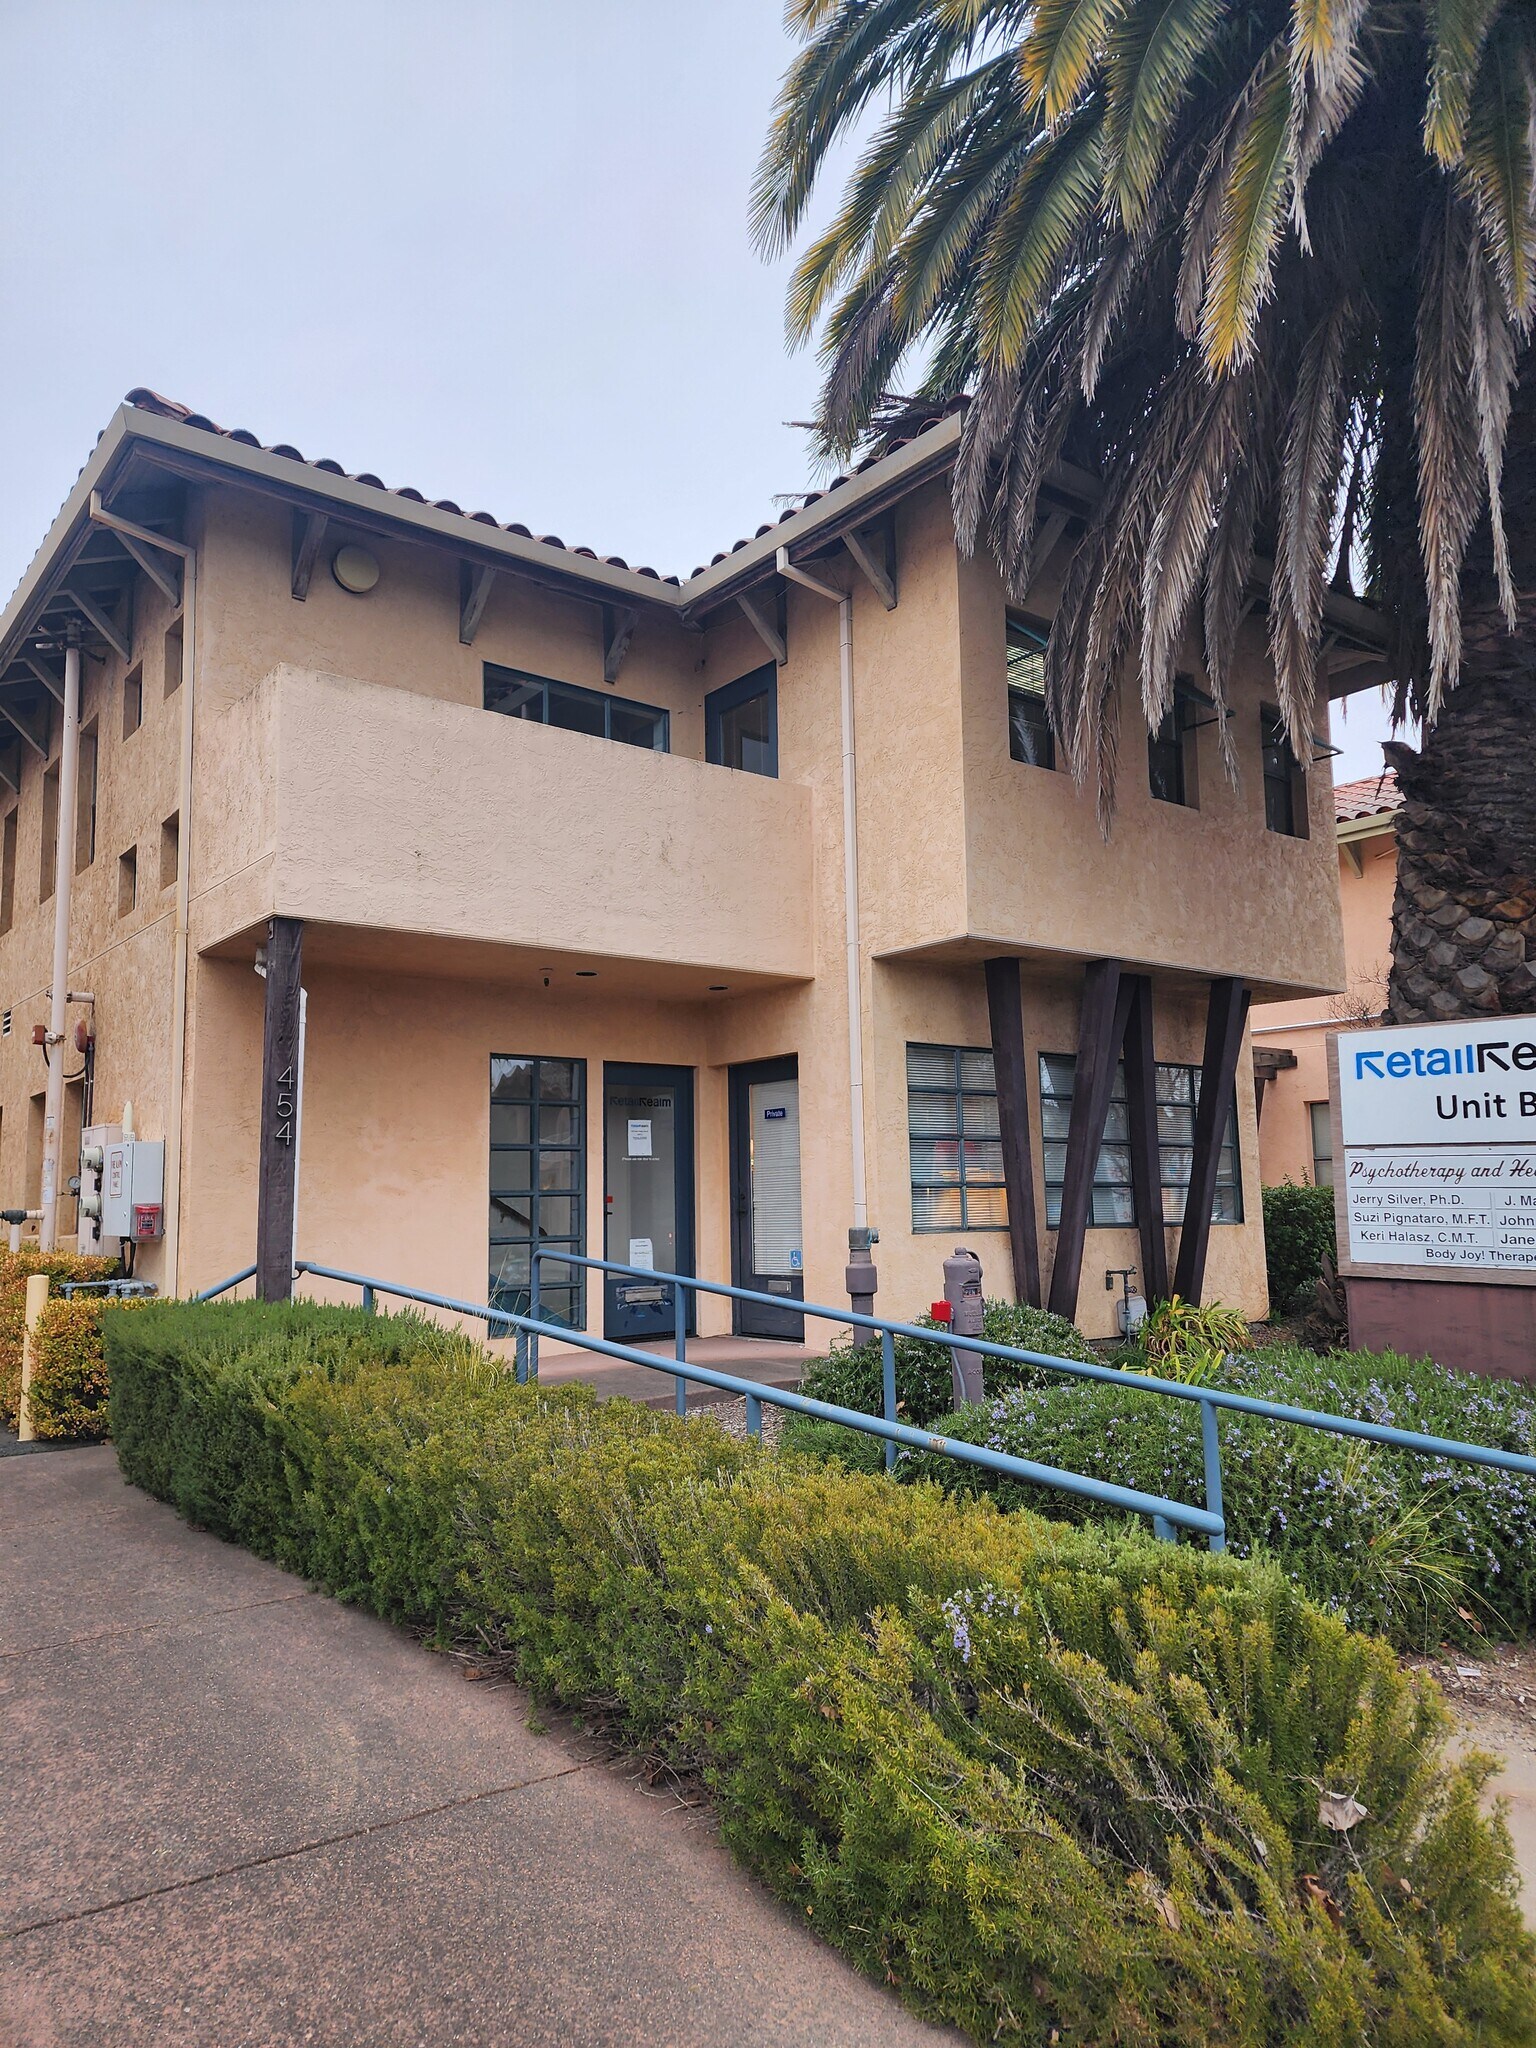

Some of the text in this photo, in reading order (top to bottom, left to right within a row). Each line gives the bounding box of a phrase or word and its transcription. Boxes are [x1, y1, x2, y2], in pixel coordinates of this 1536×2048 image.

[276, 1065, 294, 1146] 454
[1436, 1091, 1536, 1119] Unit B
[766, 1110, 783, 1118] Private
[1349, 1158, 1536, 1184] Psychotherapy and He
[1352, 1194, 1464, 1206] Jerry Silver, Ph.D.
[1504, 1195, 1516, 1206] J.
[1354, 1212, 1490, 1226] Suzi Pignataro, M.F.T.
[1499, 1215, 1535, 1226] John
[1360, 1230, 1479, 1244] Keri Halasz, C.M.T.
[1500, 1233, 1535, 1245] Jane
[1426, 1248, 1456, 1261] Body
[1460, 1249, 1485, 1262] Joy!
